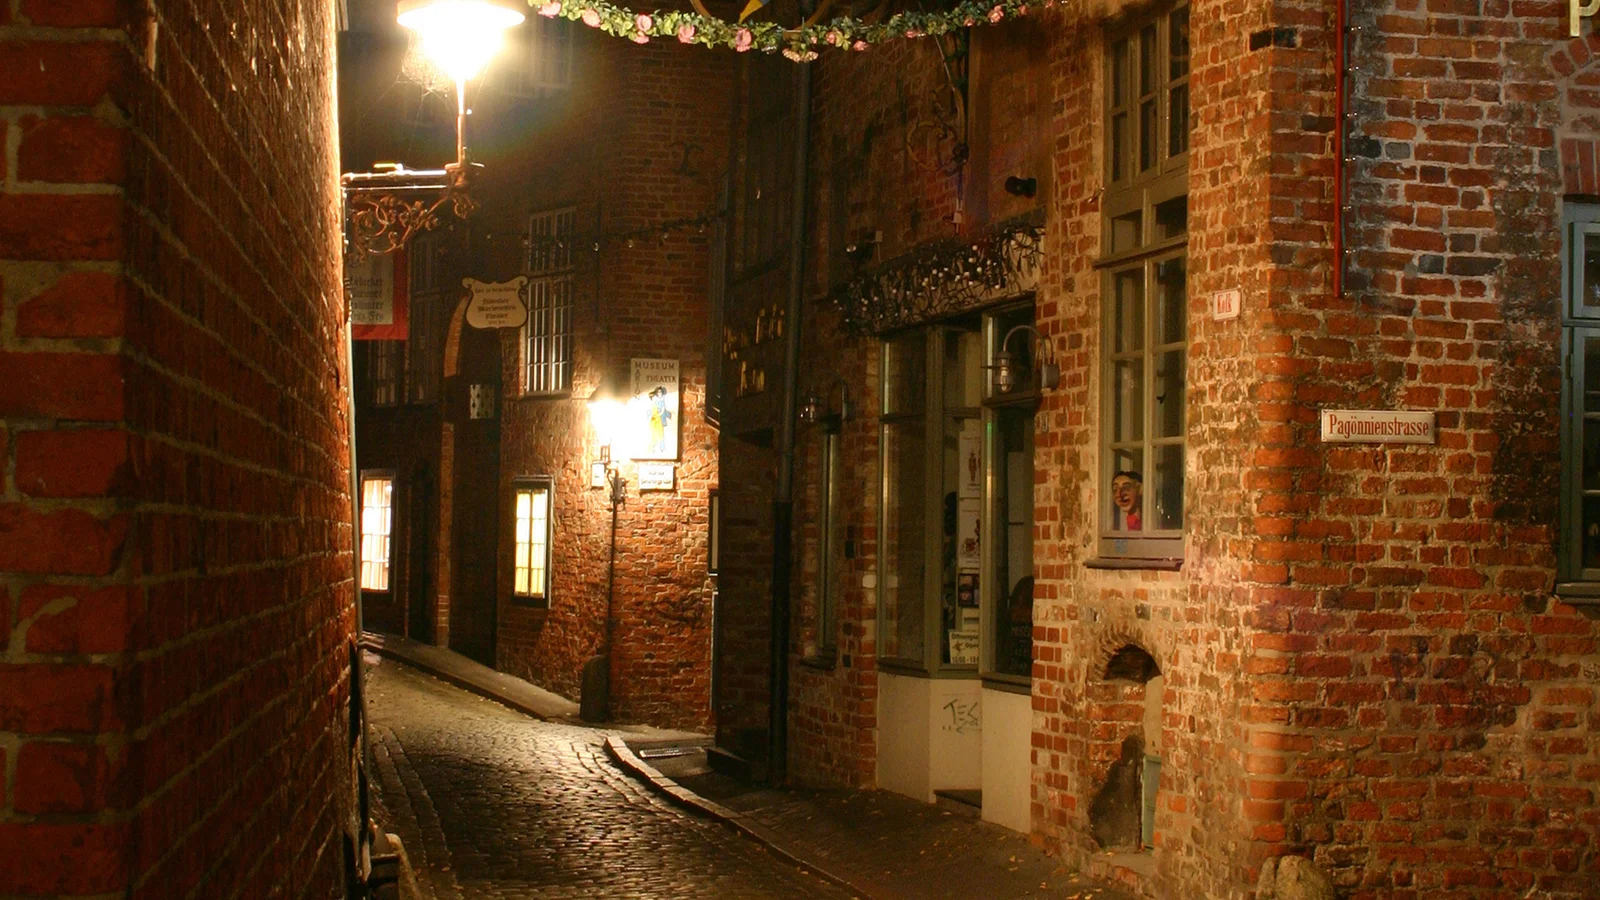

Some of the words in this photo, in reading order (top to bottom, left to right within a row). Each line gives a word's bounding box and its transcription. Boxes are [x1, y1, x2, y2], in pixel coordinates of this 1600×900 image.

[1217, 293, 1232, 314] Kolk
[634, 361, 675, 370] MUSEUM
[646, 375, 677, 383] THEATER
[1329, 414, 1429, 438] Pagönnienstrasse
